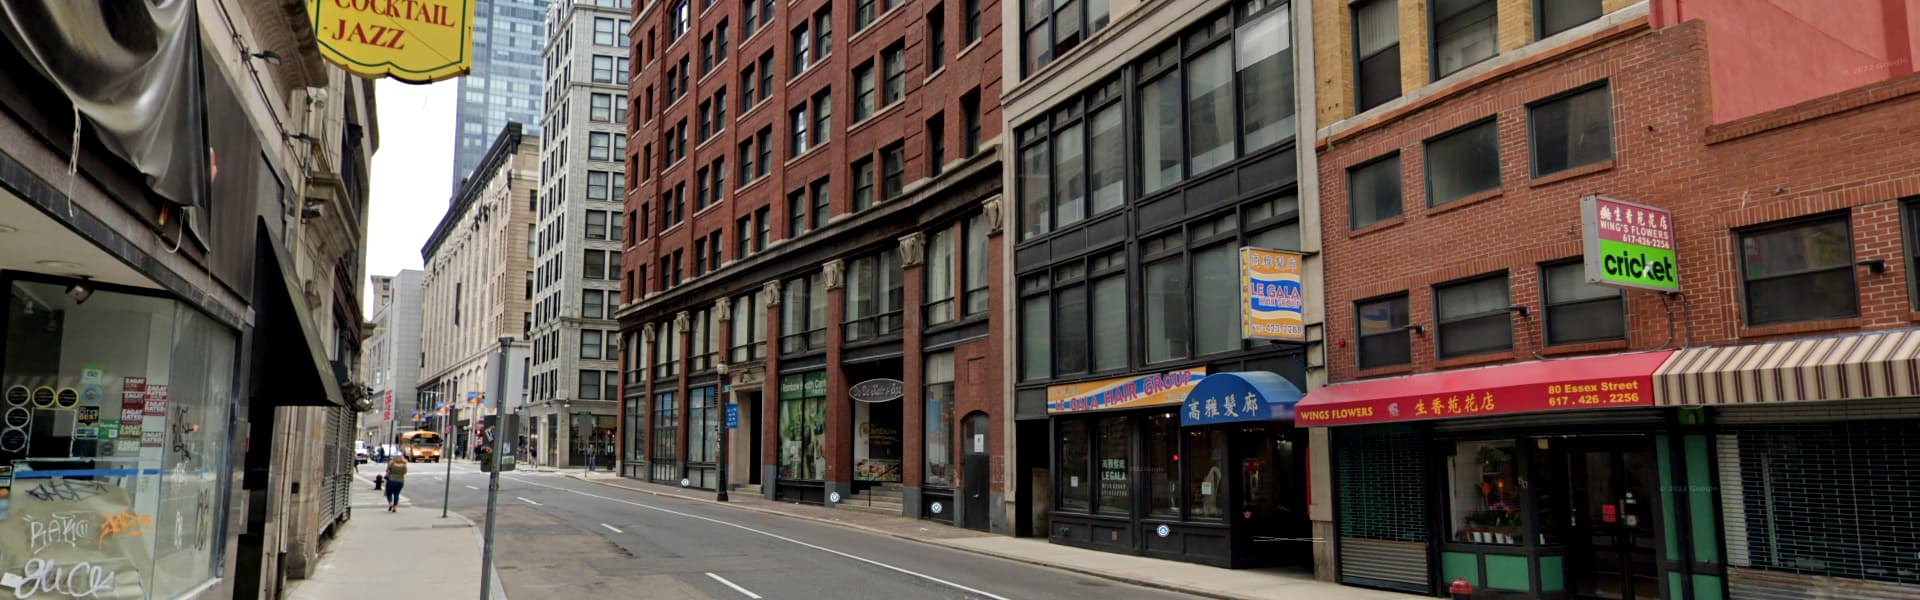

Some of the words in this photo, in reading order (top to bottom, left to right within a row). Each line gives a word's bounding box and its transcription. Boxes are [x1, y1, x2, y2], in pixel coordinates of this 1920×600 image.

[332, 19, 405, 50] JAZZ
[1600, 219, 1629, 233] WING'S
[1632, 225, 1669, 240] FLOWERS
[1623, 233, 1670, 249] 617-426-2256
[1604, 250, 1674, 282] cricket
[1251, 282, 1264, 297] LE
[1266, 284, 1300, 300] GALA
[1056, 399, 1064, 411] LE
[1070, 396, 1098, 411] GALA
[1103, 383, 1137, 407] HAIR
[1143, 371, 1192, 396] GROUP
[1549, 385, 1562, 394] 80
[1565, 383, 1598, 393] Essex
[1601, 380, 1639, 391] Street
[1549, 396, 1569, 406] 617
[1578, 394, 1600, 404] 426
[1609, 392, 1640, 403] 2256
[1301, 410, 1330, 421] WINGS
[1331, 407, 1374, 419] FLOWERS
